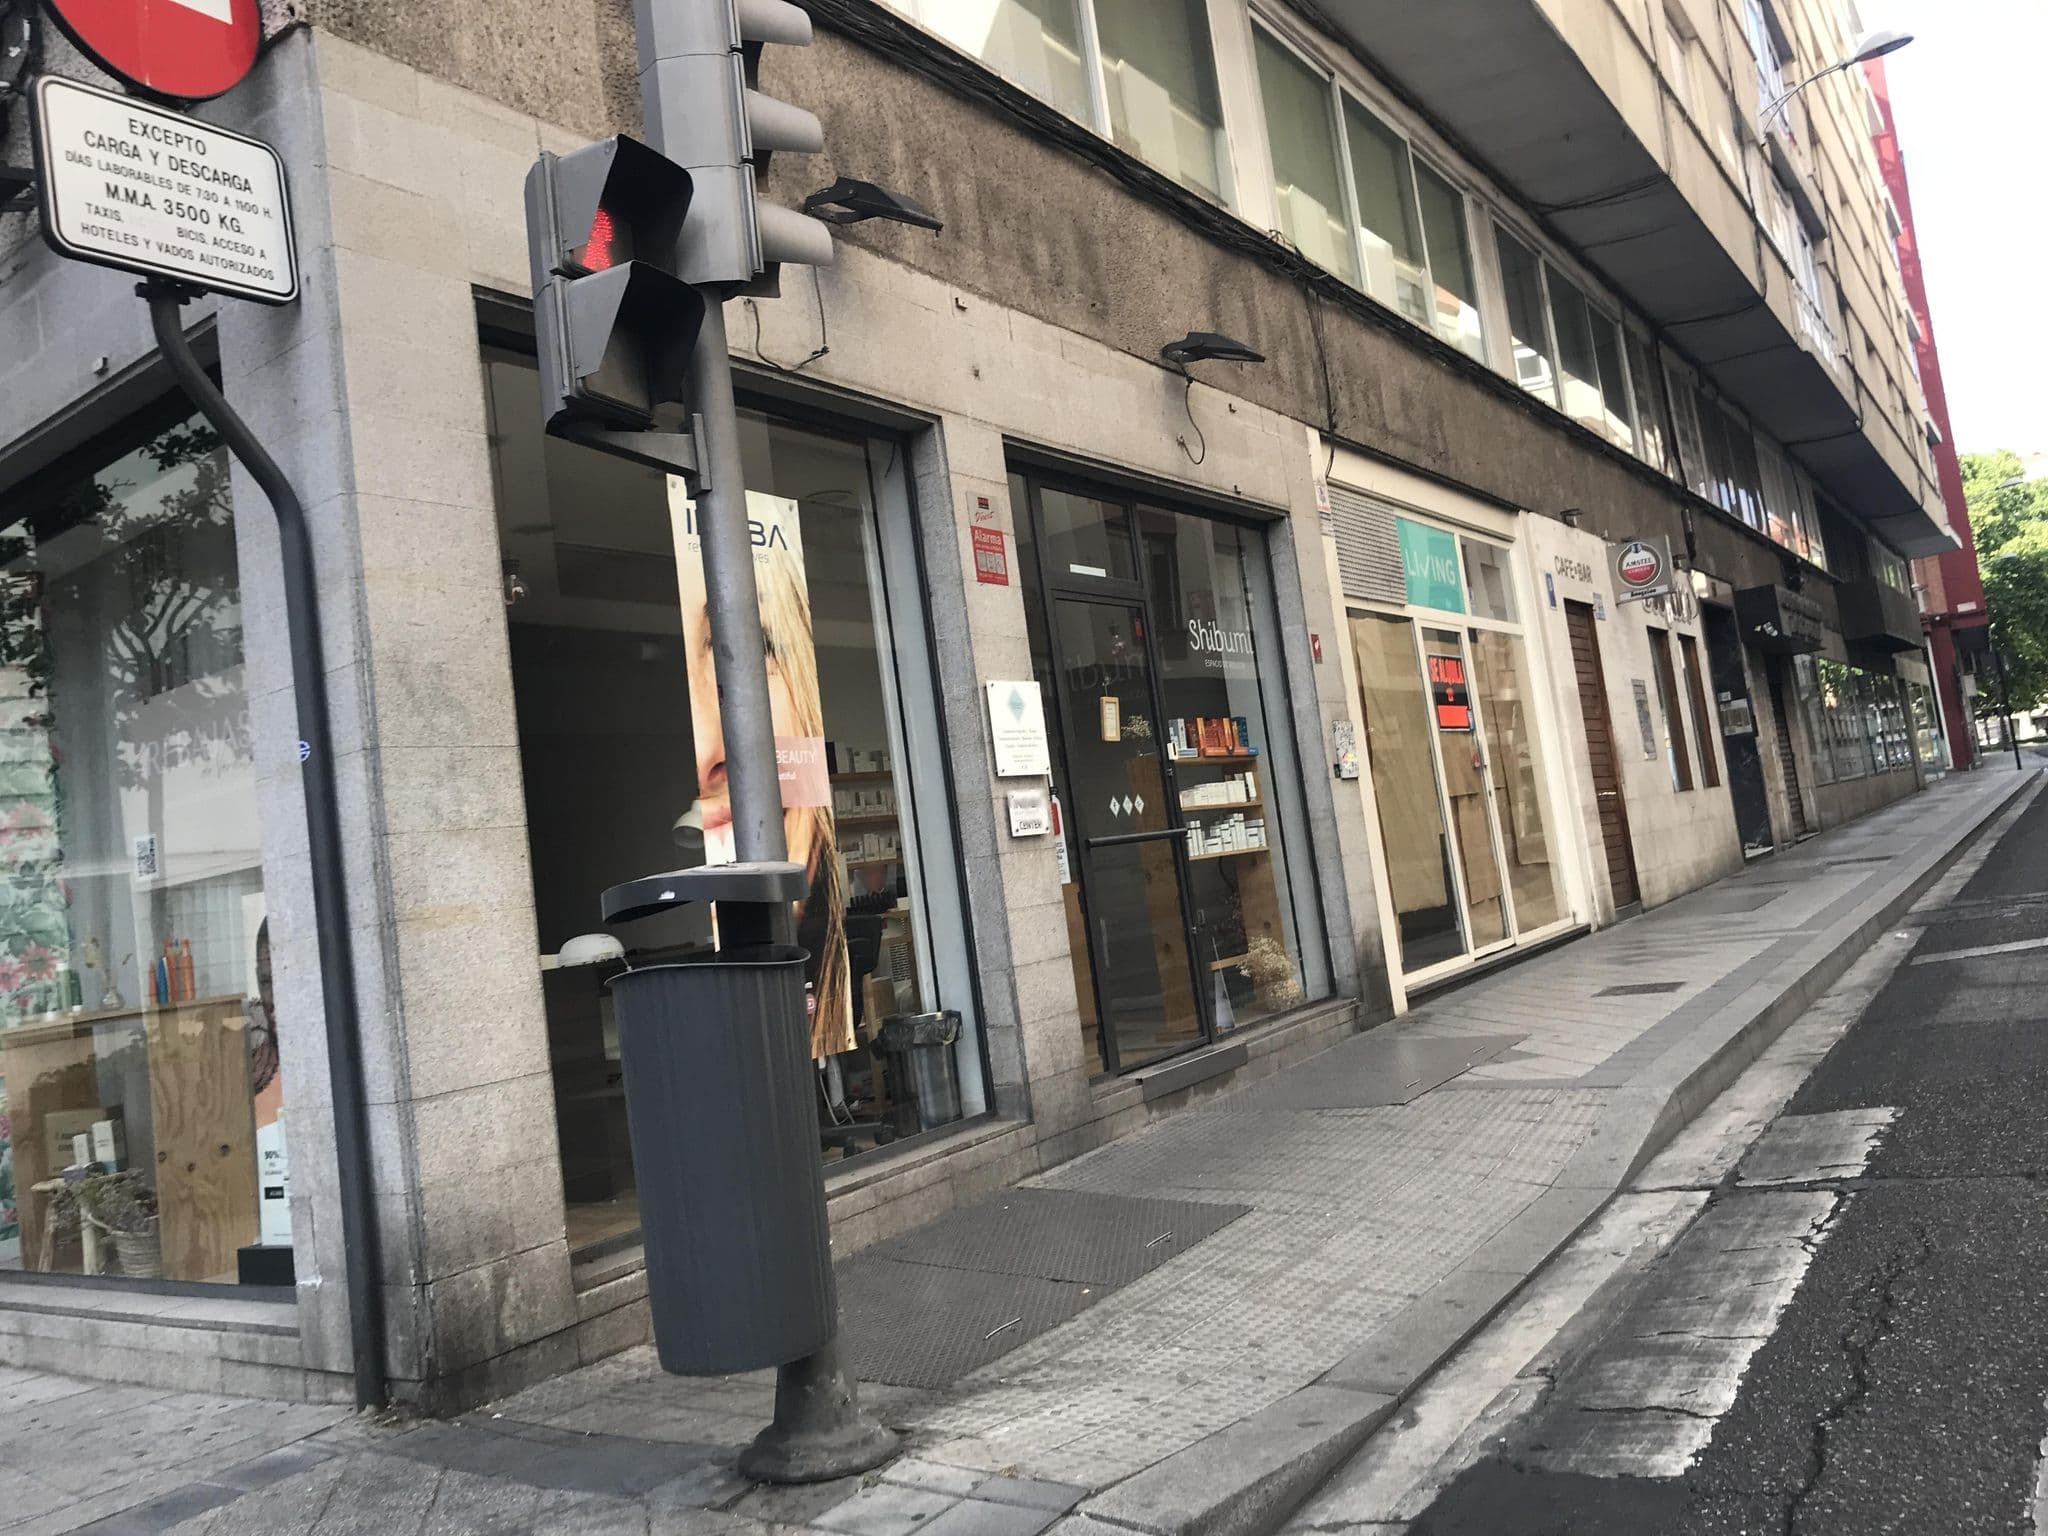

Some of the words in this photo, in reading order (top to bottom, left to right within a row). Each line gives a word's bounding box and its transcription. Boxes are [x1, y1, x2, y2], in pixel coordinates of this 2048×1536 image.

[128, 118, 206, 155] EXCEPTO
[84, 130, 142, 161] CARGA
[149, 149, 159, 166] Y
[168, 154, 253, 194] DESCARGA
[97, 160, 173, 190] LABORABLES
[176, 182, 191, 196] DE
[224, 195, 231, 207] A
[163, 198, 210, 225] 3500
[81, 223, 139, 247] HOTELES
[143, 238, 151, 250] Y
[156, 242, 195, 260] VADOS
[200, 253, 275, 280] AUTORIZADOS
[212, 236, 255, 256] ACCESO
[259, 249, 267, 260] A
[1404, 548, 1456, 586] LIVING
[1625, 557, 1653, 567] AMSTEL
[1188, 618, 1254, 655] Shibumi
